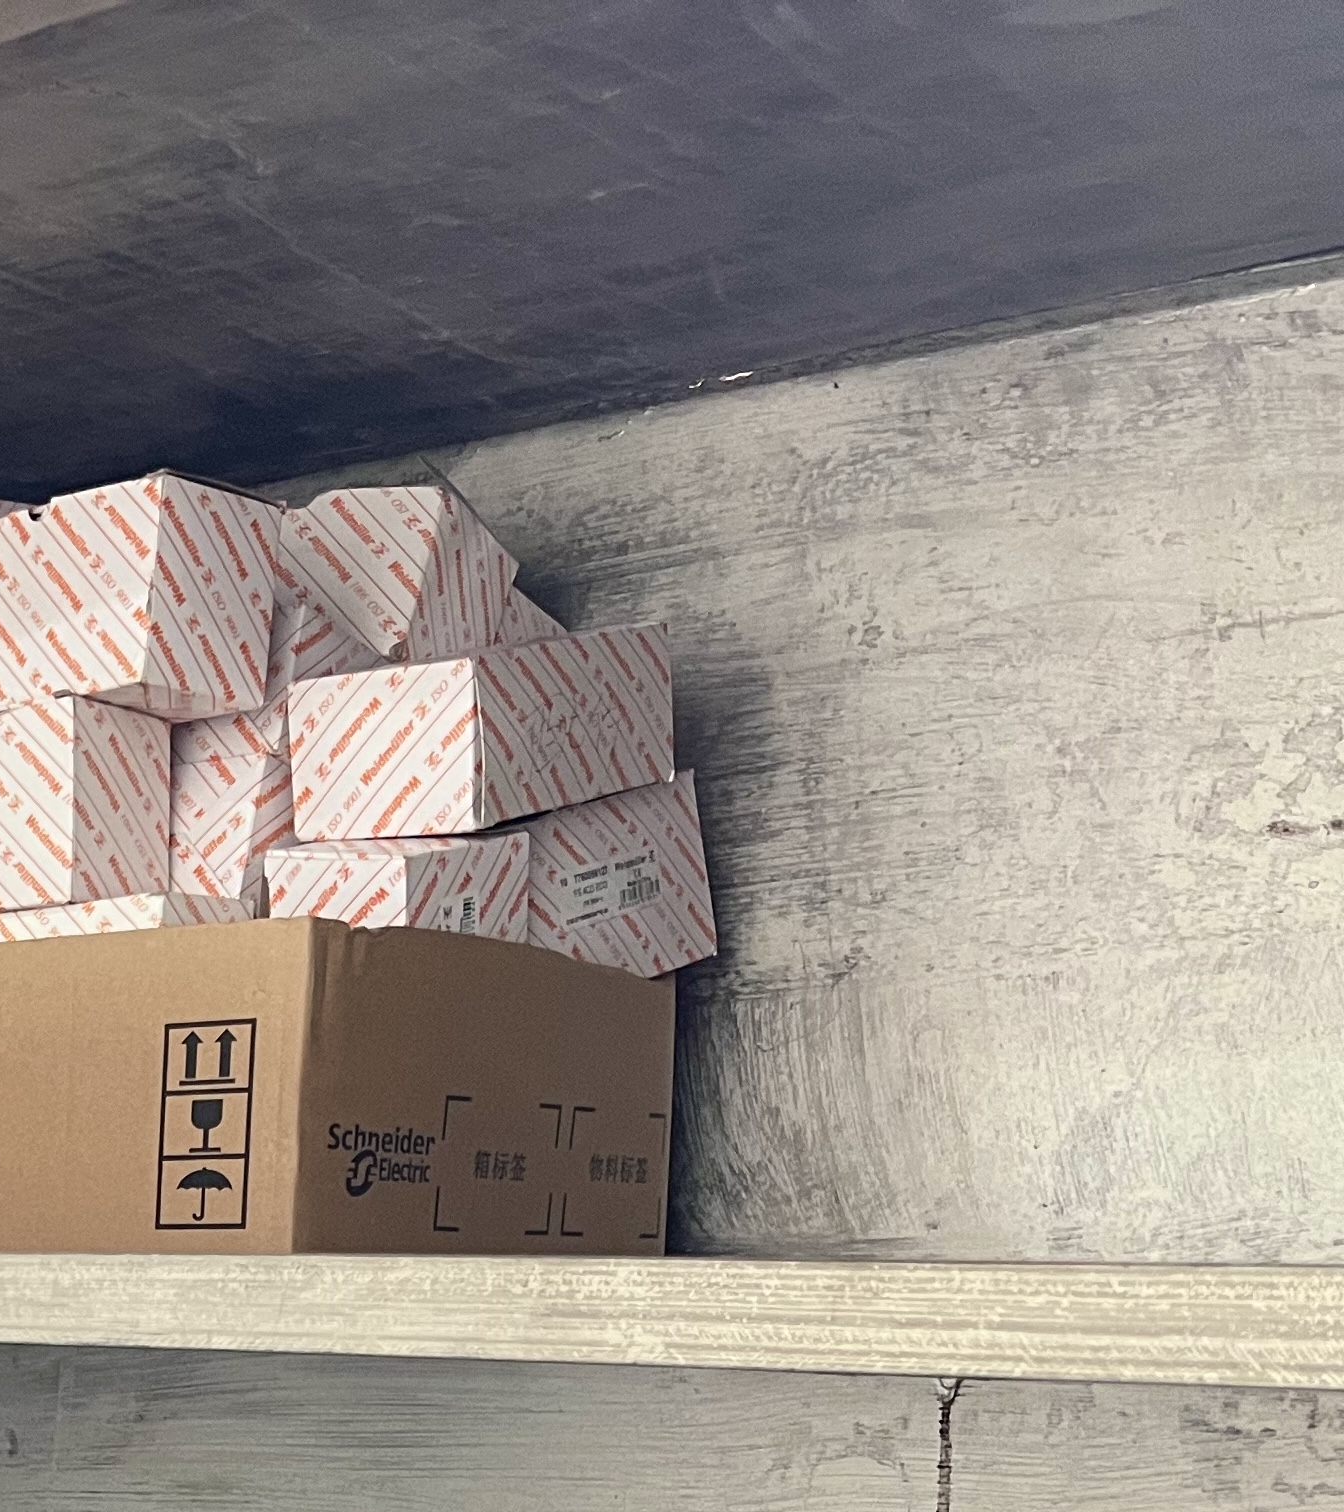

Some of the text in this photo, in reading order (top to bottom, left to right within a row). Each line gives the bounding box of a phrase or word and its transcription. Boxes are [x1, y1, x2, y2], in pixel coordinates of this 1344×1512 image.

[360, 719, 414, 786] Weidmüller
[327, 1123, 435, 1156] Schneider
[378, 1155, 431, 1184] Electric
